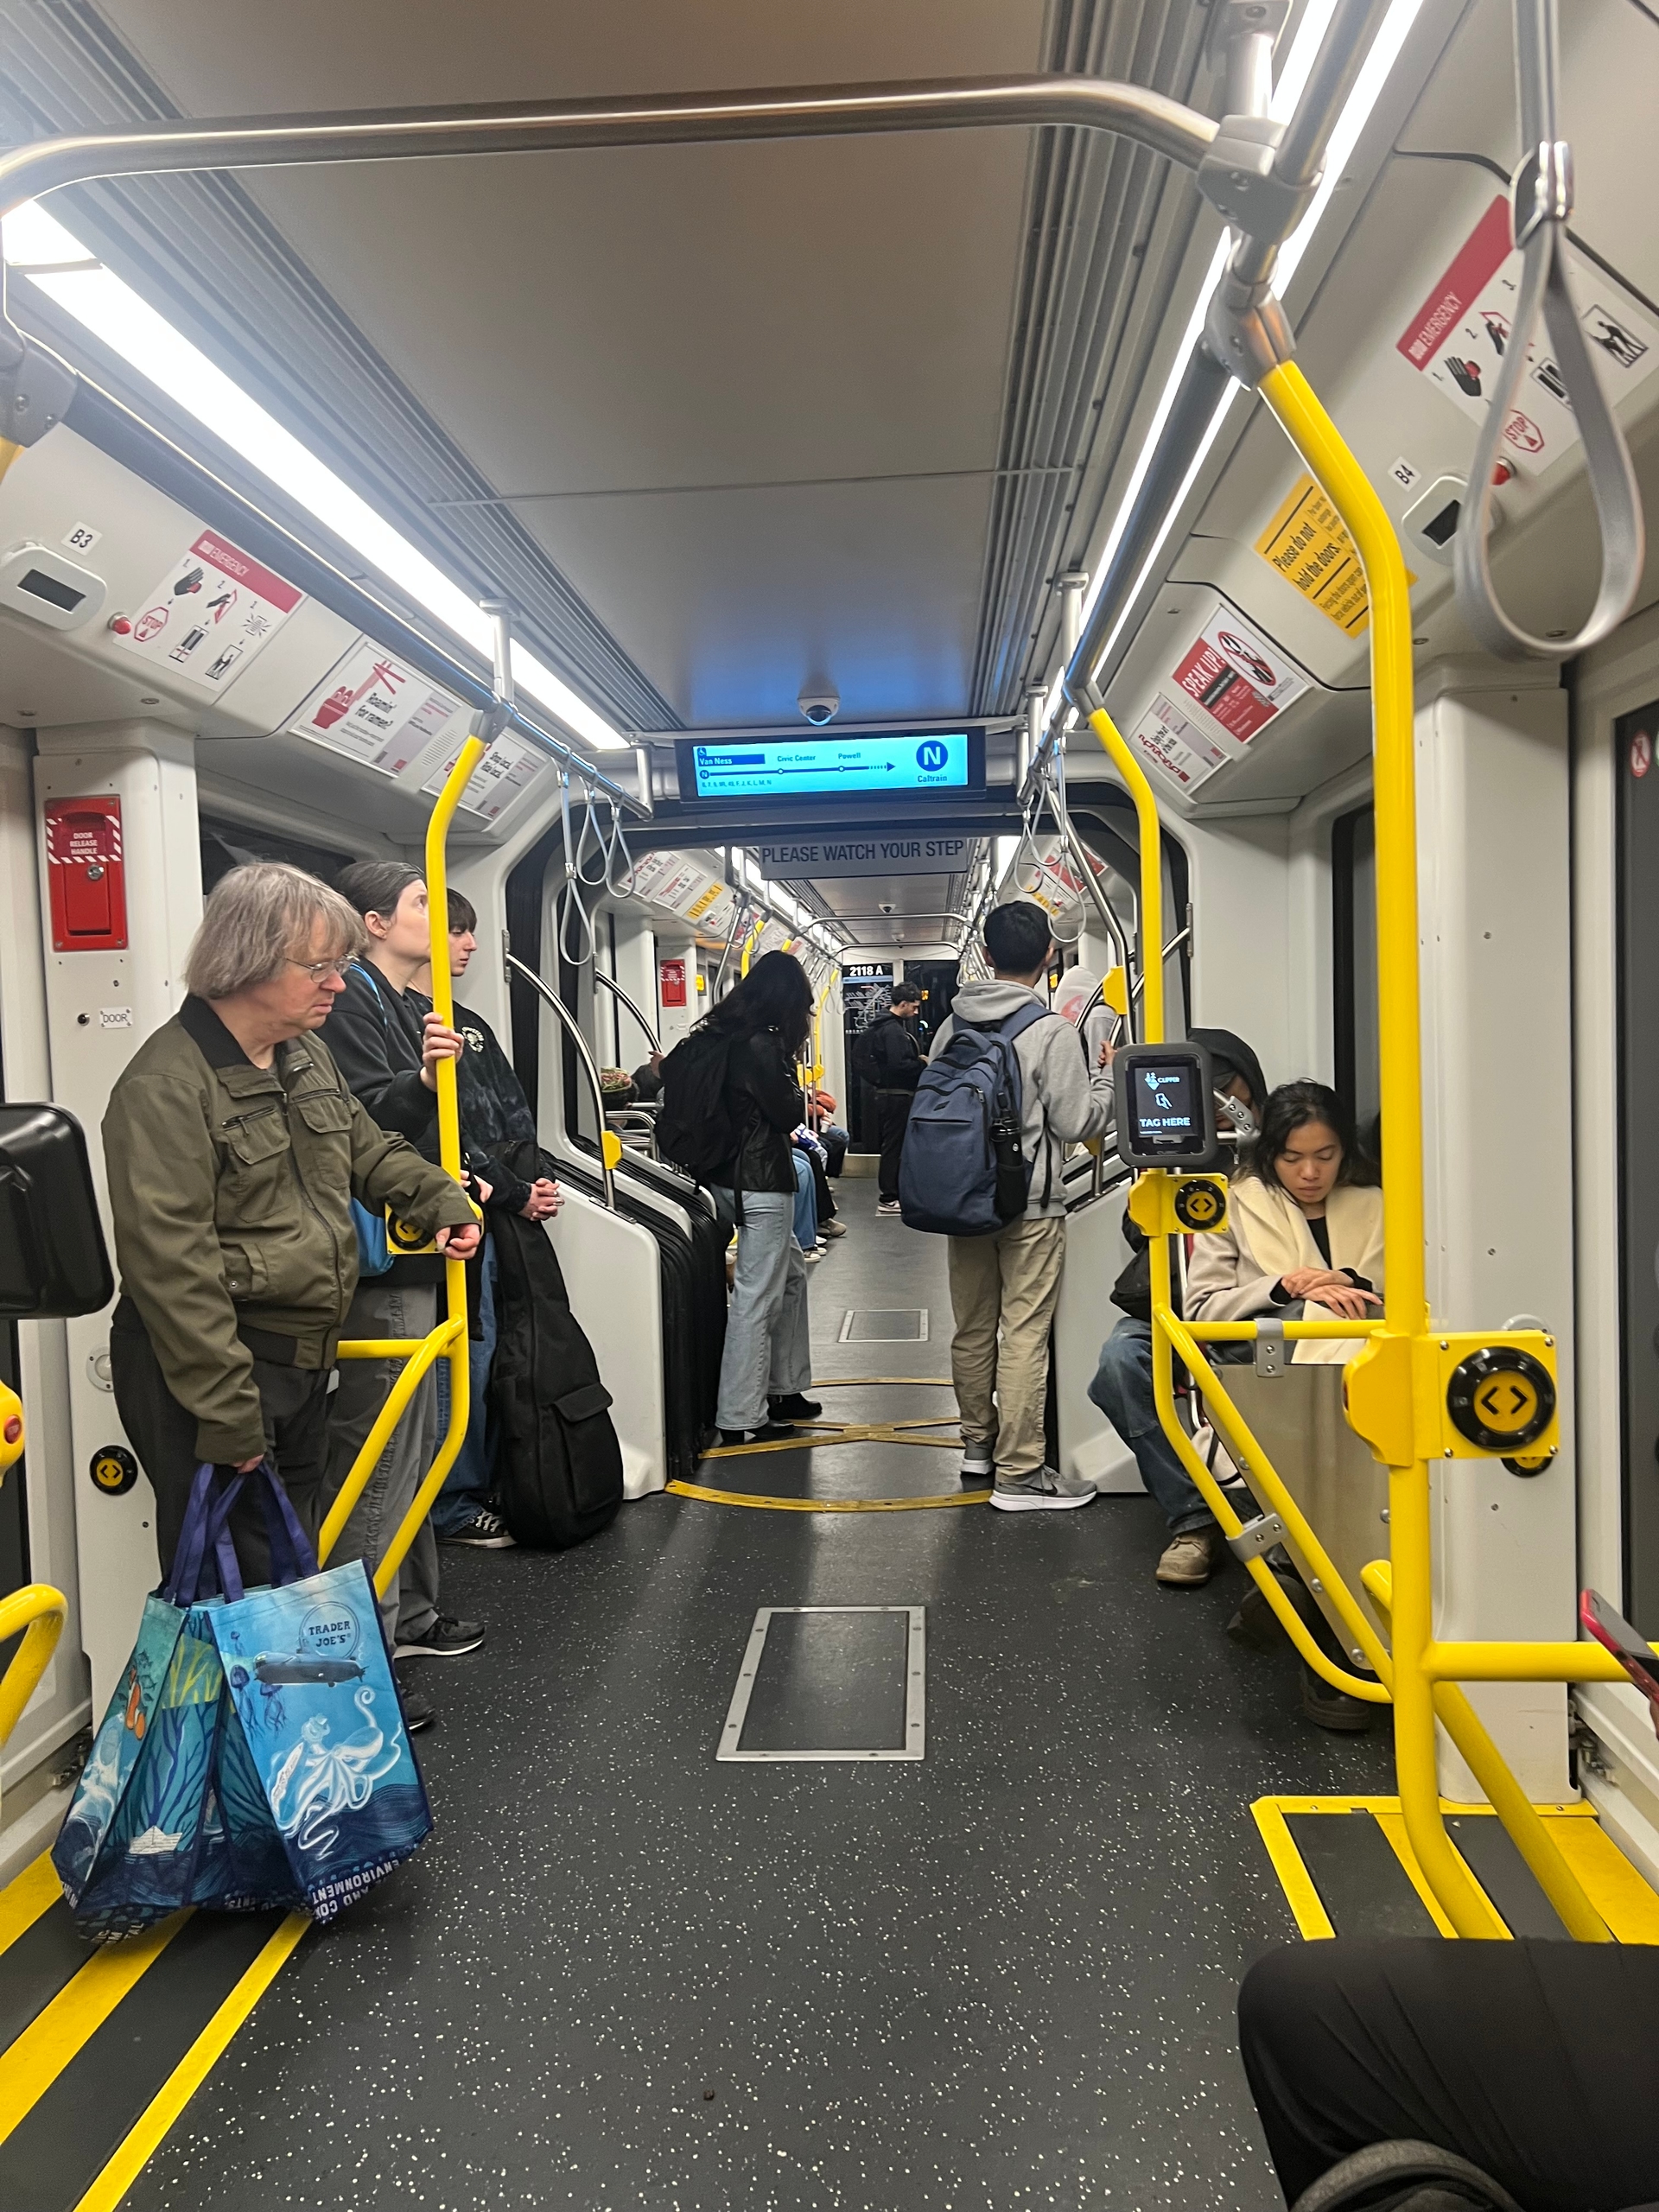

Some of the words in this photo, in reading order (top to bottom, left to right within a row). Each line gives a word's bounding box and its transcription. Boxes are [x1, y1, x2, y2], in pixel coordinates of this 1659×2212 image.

[1418, 291, 1463, 346] EMERGENCY
[1504, 416, 1529, 441] STOP
[1395, 464, 1415, 485] B4
[70, 529, 92, 548] B3
[1272, 545, 1300, 572] Please
[1290, 536, 1306, 550] do
[1300, 521, 1317, 542] not
[1313, 543, 1341, 567] doors.
[1305, 562, 1324, 577] the
[1292, 568, 1315, 591] hold
[142, 615, 164, 630] STOP
[1182, 662, 1214, 697] SPEAK
[1199, 647, 1226, 673] UP!
[924, 747, 941, 766] N
[918, 773, 947, 782] Caltrain
[70, 839, 98, 848] RELEASE
[71, 847, 98, 855] HANDLE
[762, 846, 818, 863] PLEASE
[823, 844, 875, 861] WATCH
[880, 842, 920, 859] YOUR
[925, 840, 963, 856] STEP
[849, 966, 874, 976] 2118
[875, 965, 883, 976] A
[103, 1013, 128, 1023] DOOR
[1139, 1118, 1160, 1128] TAG
[1162, 1116, 1191, 1127] HERE
[308, 1620, 351, 1636] TRADER
[312, 1859, 400, 1904] ENVIRONMENT
